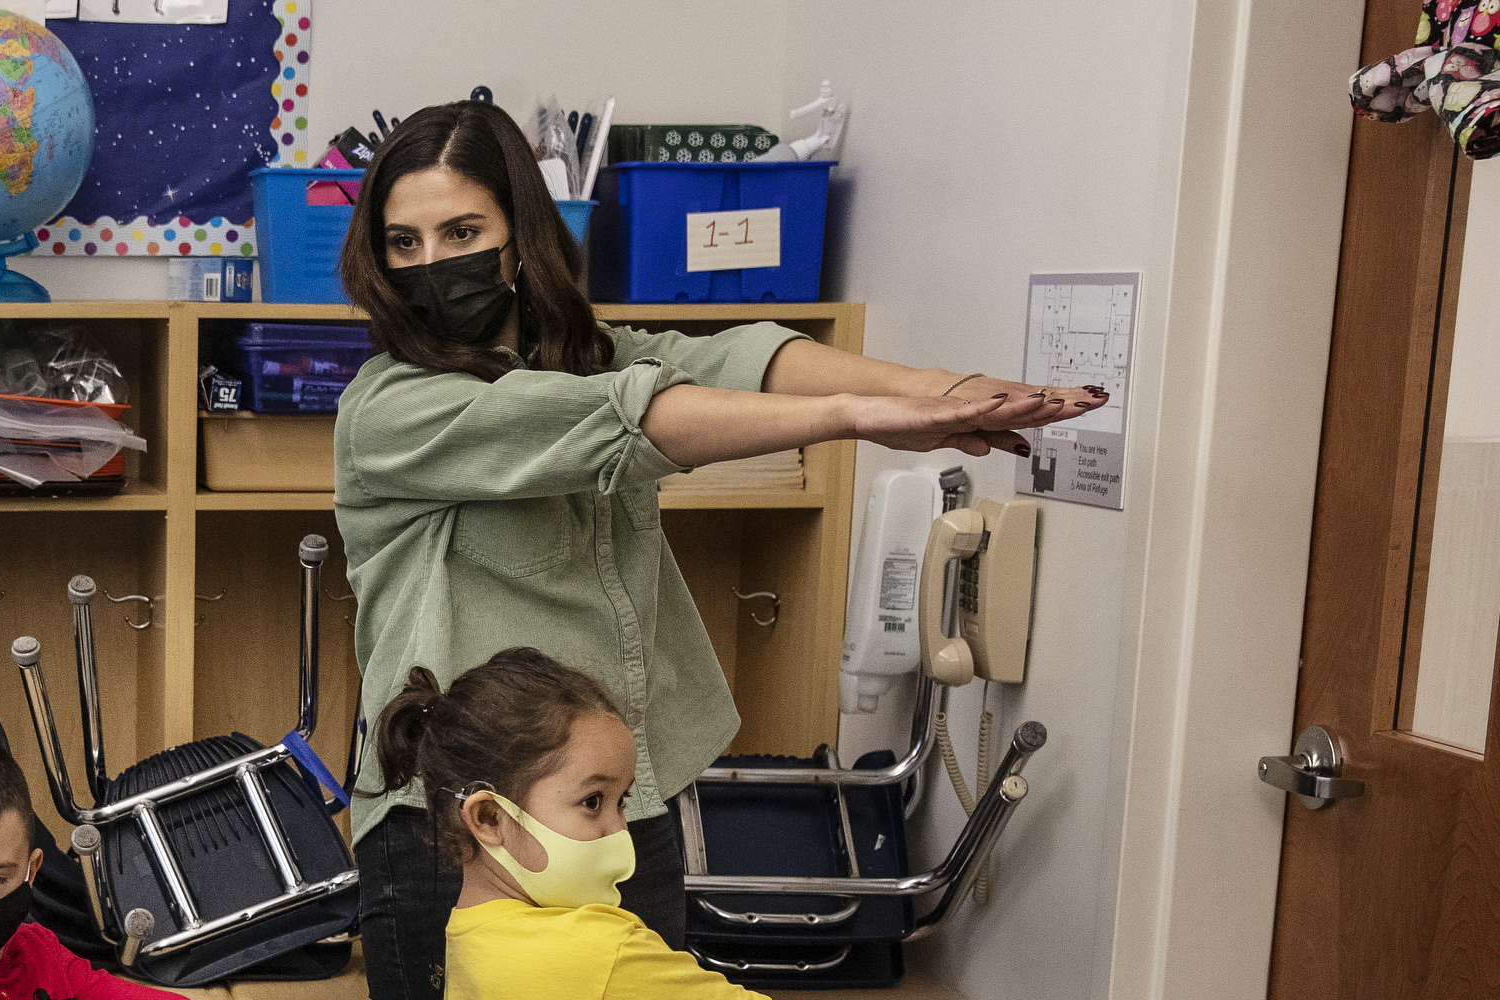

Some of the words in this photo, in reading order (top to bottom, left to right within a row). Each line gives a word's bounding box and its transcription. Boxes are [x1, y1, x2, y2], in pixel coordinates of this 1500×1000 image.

[351, 143, 375, 162] Zipl
[703, 218, 754, 249] 1-1
[219, 387, 237, 402] 75
[1079, 443, 1088, 454] You
[1096, 445, 1108, 456] Here
[1078, 456, 1087, 467] Exit
[1087, 458, 1097, 468] path
[1077, 469, 1100, 481] Accessible
[1101, 473, 1109, 482] exit
[1109, 474, 1120, 484] path
[1076, 481, 1086, 491] Area
[1092, 484, 1109, 497] Refuge
